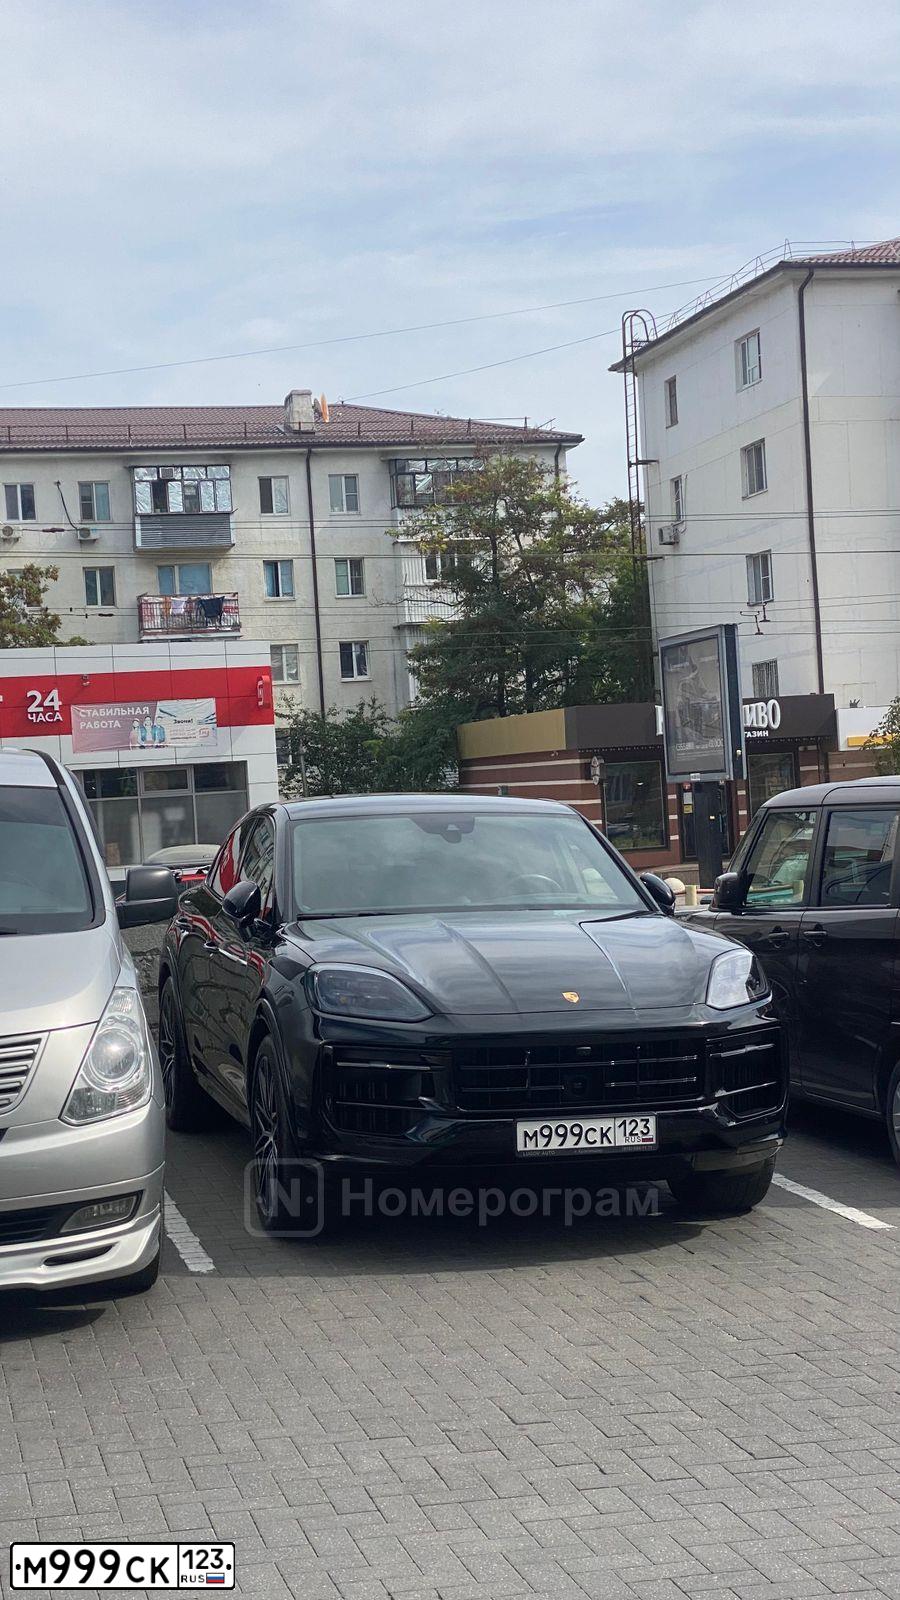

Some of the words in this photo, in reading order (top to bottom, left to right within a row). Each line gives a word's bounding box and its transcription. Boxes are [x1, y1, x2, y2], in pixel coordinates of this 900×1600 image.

[26, 689, 62, 713] 24
[28, 712, 63, 723] ЧАСА
[80, 706, 150, 718] СТАБИЛЬНАЯ
[80, 720, 121, 730] РАБОТА
[744, 730, 769, 738] ГАЗИН
[617, 1118, 650, 1138] 123
[624, 1136, 641, 1144] RUS
